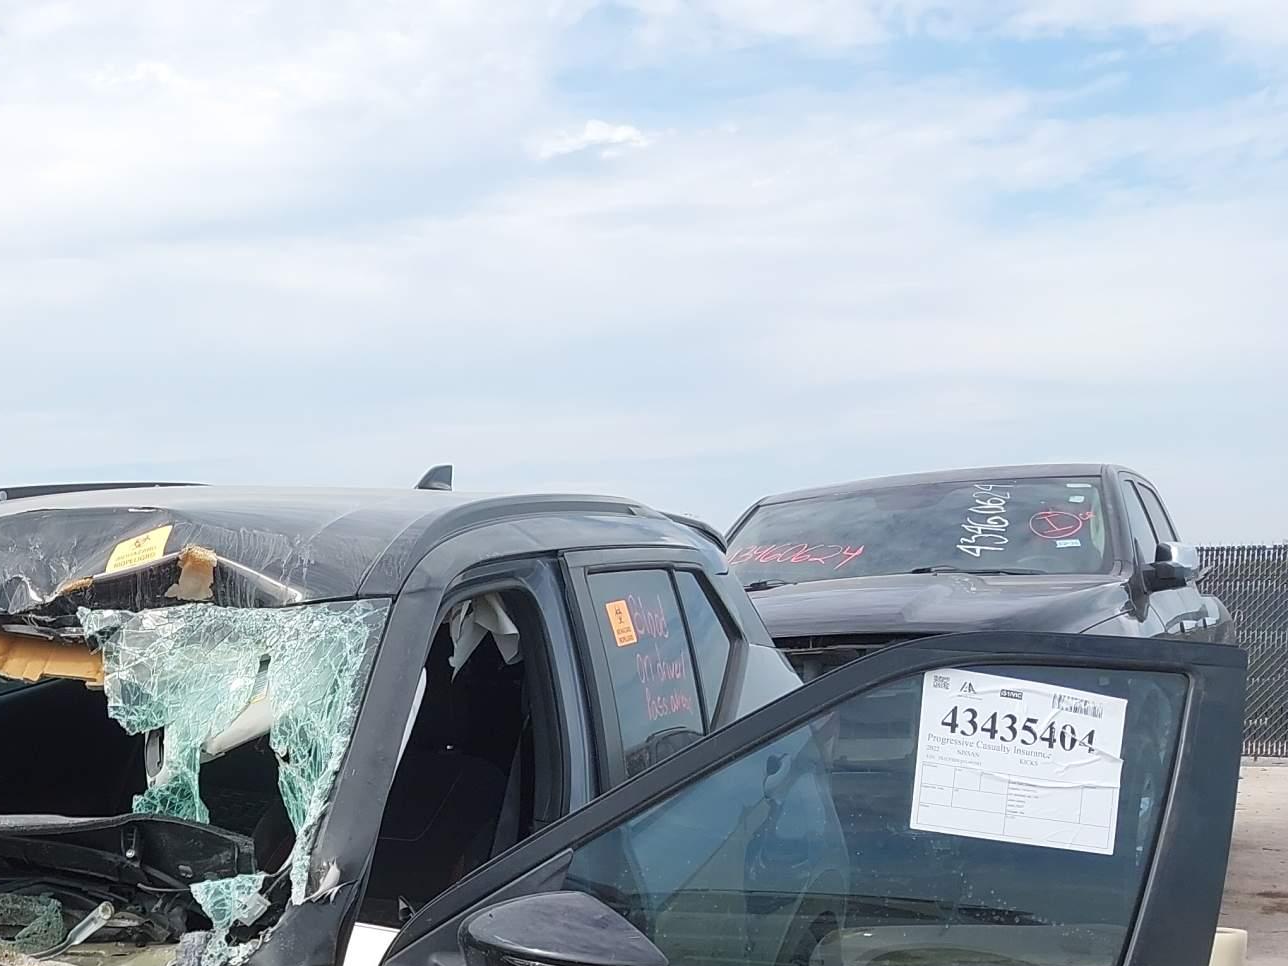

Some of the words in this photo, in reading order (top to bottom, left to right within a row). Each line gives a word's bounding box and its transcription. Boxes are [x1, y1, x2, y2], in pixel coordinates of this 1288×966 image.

[957, 484, 1014, 557] 43460624
[927, 733, 974, 747] Progressive
[976, 740, 1011, 754] Casualty
[1013, 746, 1052, 759] Insurance
[941, 705, 1095, 754] 43435404
